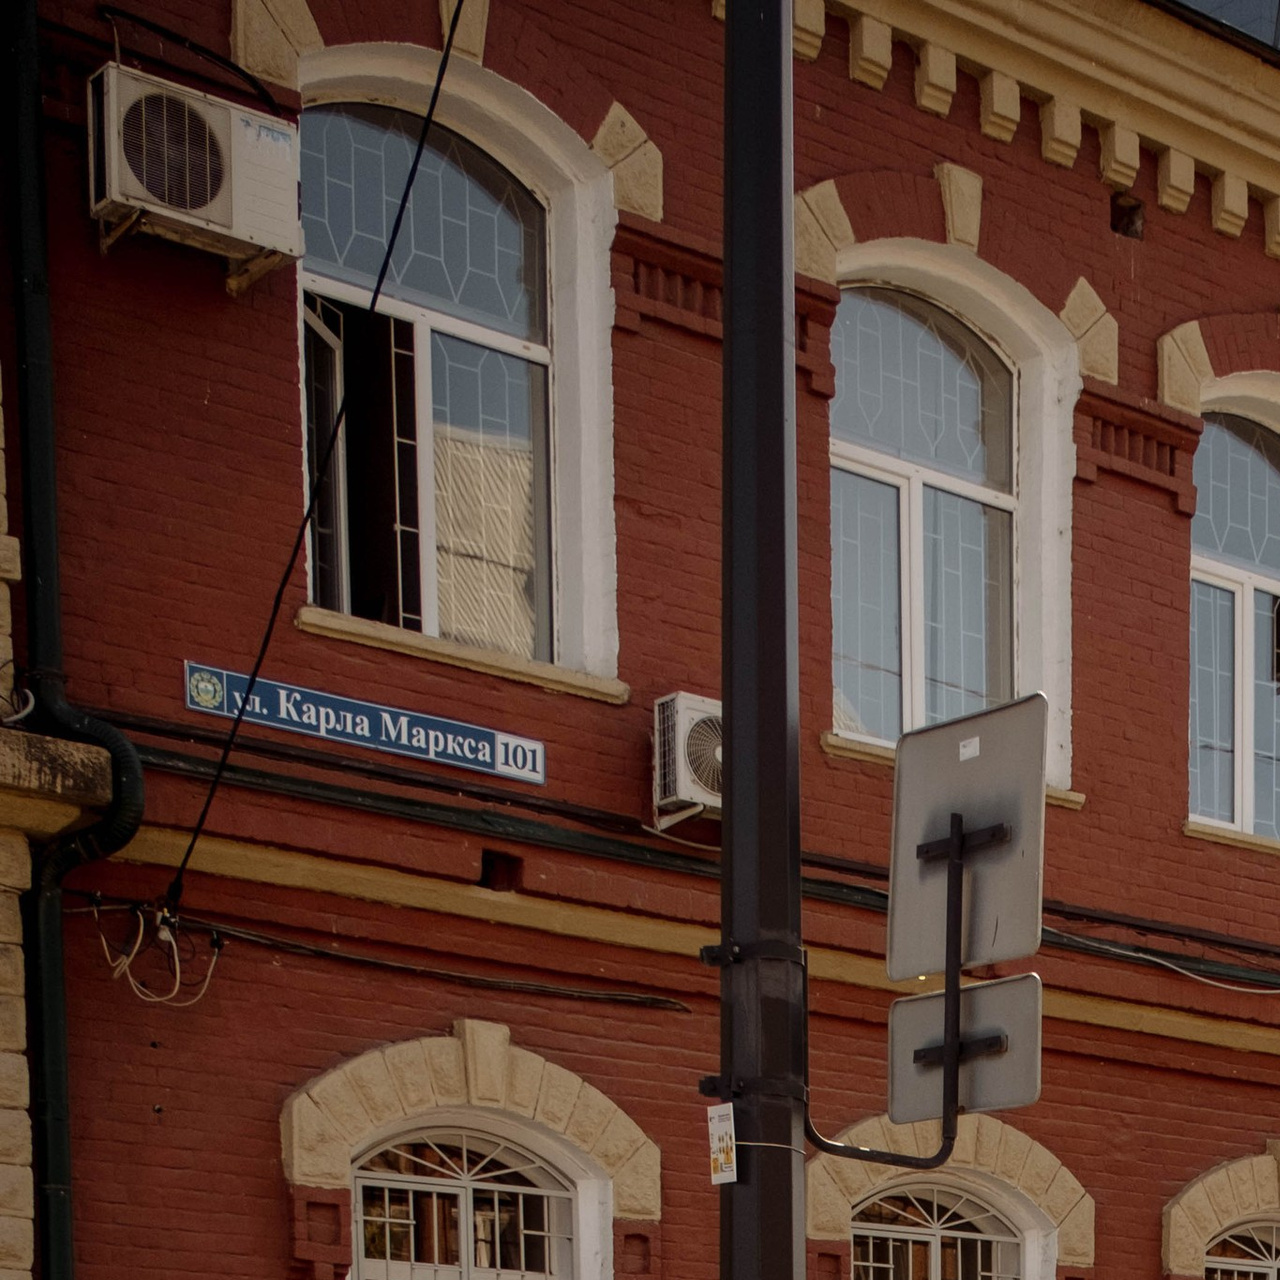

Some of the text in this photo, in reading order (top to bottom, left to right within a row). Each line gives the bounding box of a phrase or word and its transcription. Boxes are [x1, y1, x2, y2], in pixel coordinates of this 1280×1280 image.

[233, 688, 540, 774] ул. Карла Маркса 101
